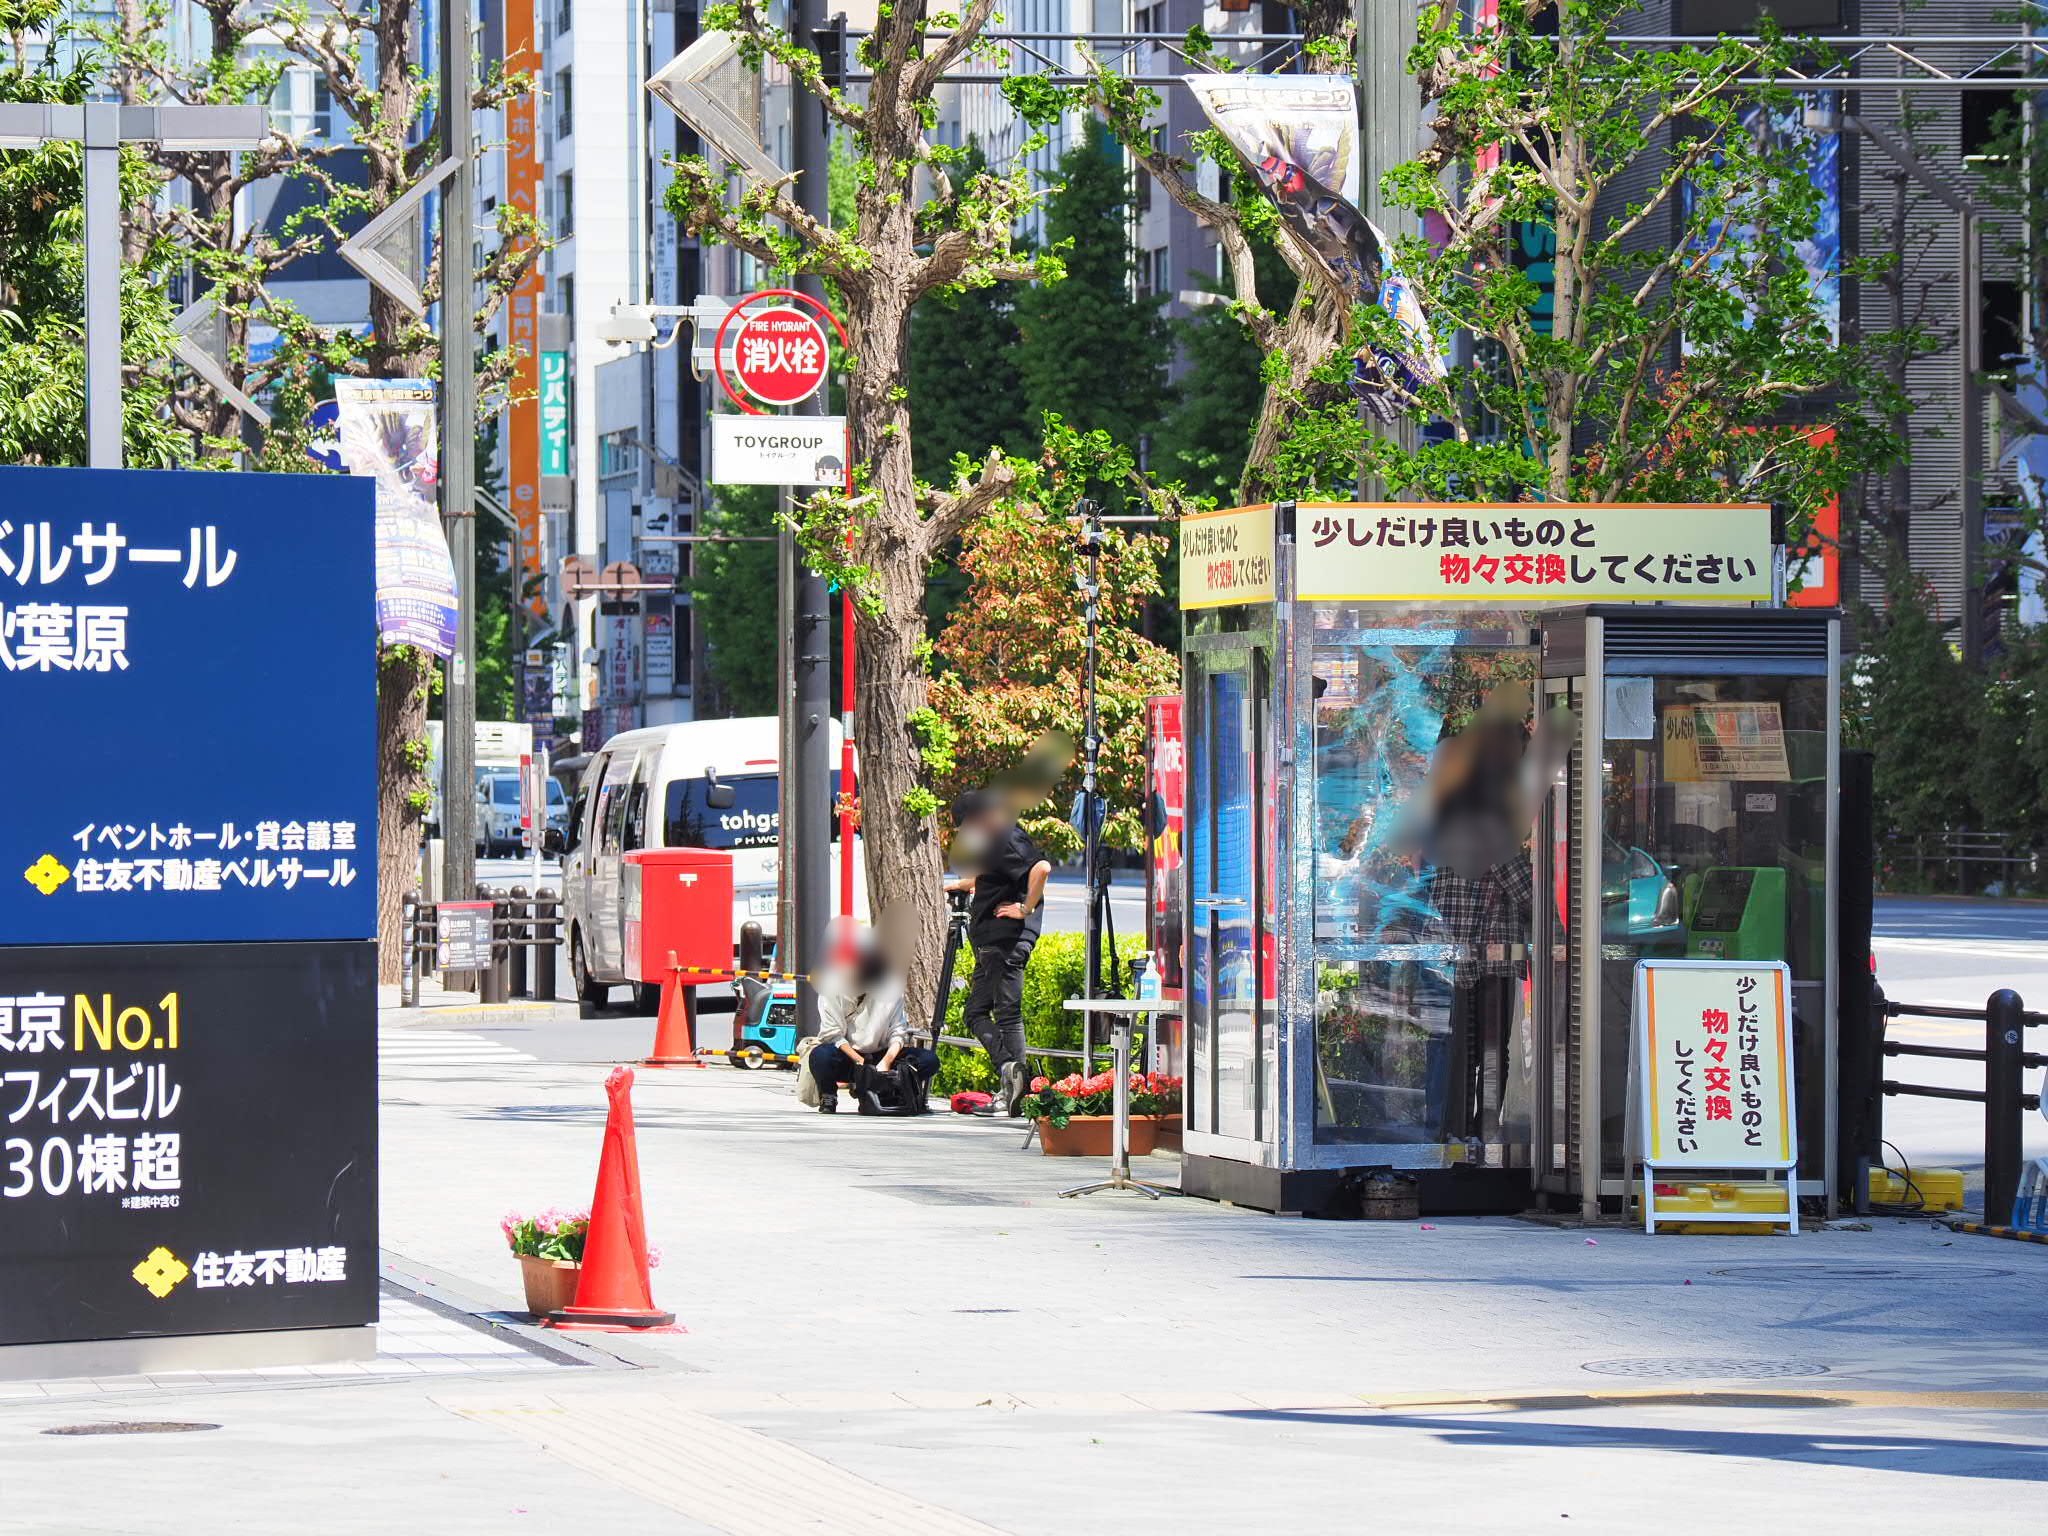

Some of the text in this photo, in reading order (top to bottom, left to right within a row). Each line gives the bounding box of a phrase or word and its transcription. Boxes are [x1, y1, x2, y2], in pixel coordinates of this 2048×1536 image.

[750, 321, 812, 332] FIRE HYDRANT
[743, 337, 820, 374] 消火栓
[543, 356, 566, 470] リバティー
[734, 436, 823, 449] TOYGROUP
[1182, 524, 1239, 558] 少しだけ良いものと
[1311, 516, 1596, 548] 少しだけ良いものと
[0, 520, 237, 588] ルサール
[1207, 555, 1271, 590] 物々交換してください
[1440, 553, 1757, 584] 物々交換してください
[73, 821, 356, 851] イベントホール・貸会議室
[73, 857, 356, 892] 住友不動産ベルサール
[74, 992, 179, 1051] No.1
[1702, 1008, 1733, 1121] 物々交換
[1736, 976, 1762, 1147] 少しだけ良いものと
[0, 1062, 181, 1124] フィスビル
[1674, 1039, 1698, 1154] してください
[3, 1133, 181, 1197] 30棟超
[193, 1246, 347, 1289] 住友不動産
